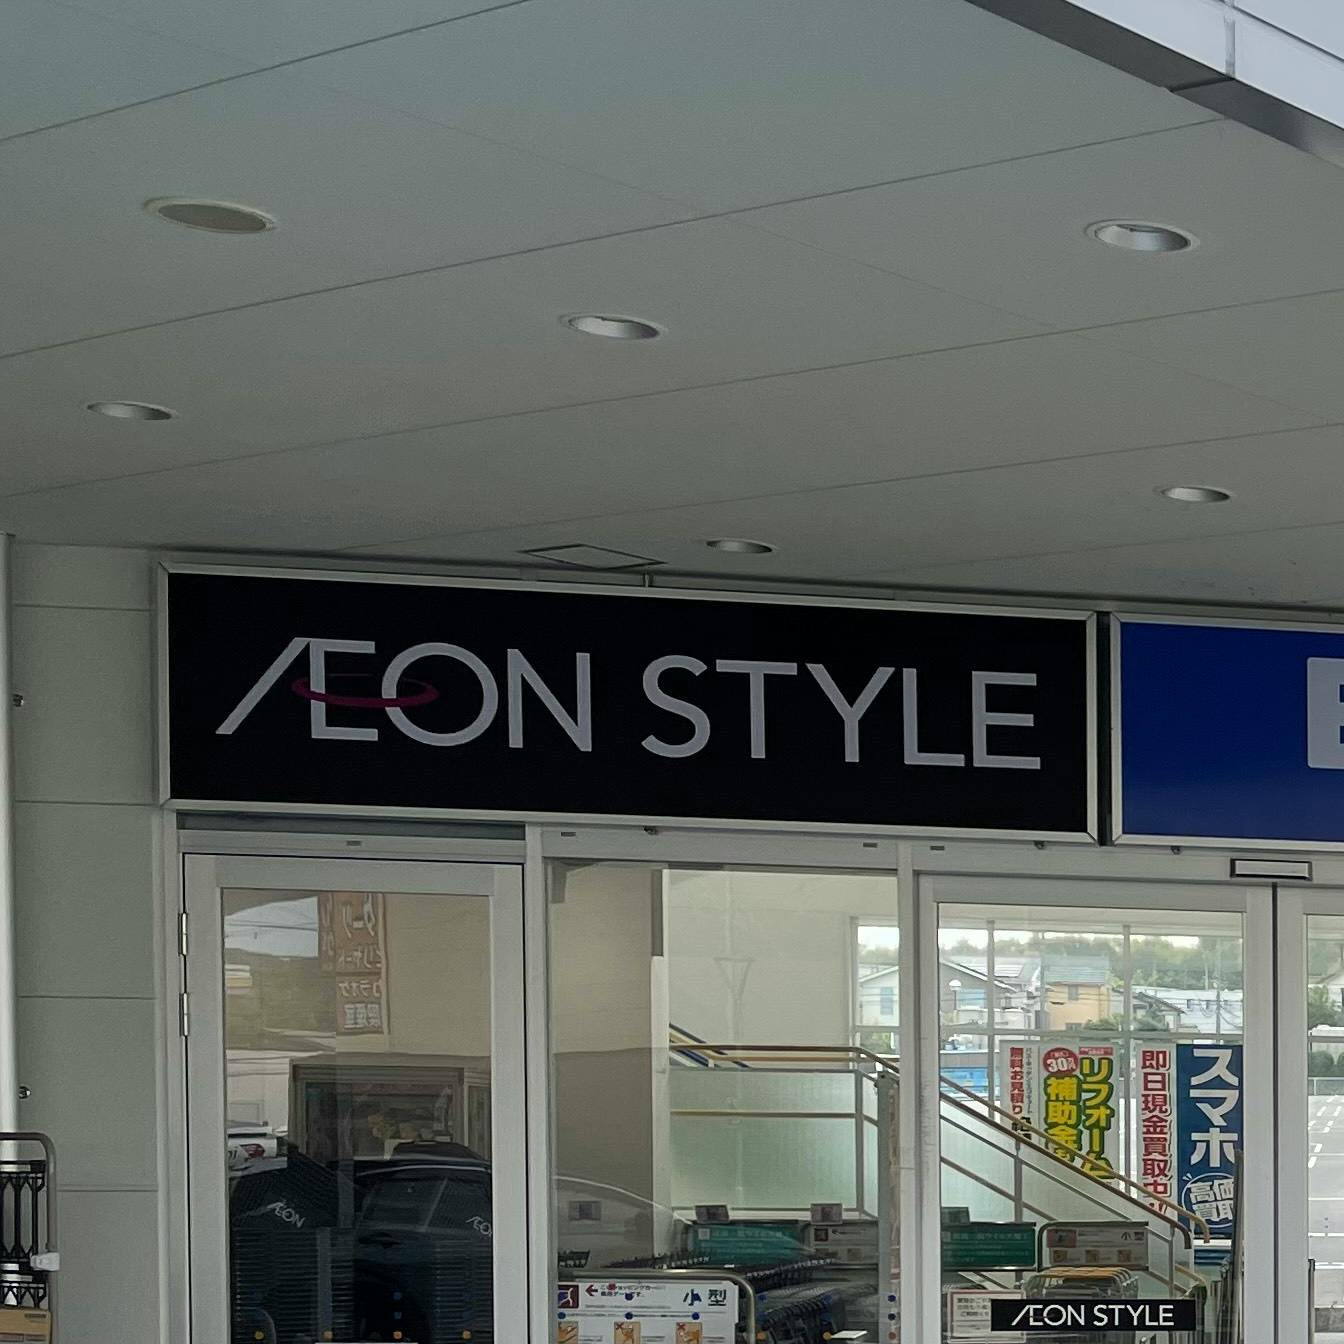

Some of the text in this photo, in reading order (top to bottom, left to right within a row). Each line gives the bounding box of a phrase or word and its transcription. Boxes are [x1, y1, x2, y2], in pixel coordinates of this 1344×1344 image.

[641, 655, 1041, 769] STYLE
[1190, 1048, 1240, 1168] スマホ
[683, 1289, 727, 1306] 小型
[1093, 1304, 1175, 1326] STYLE
